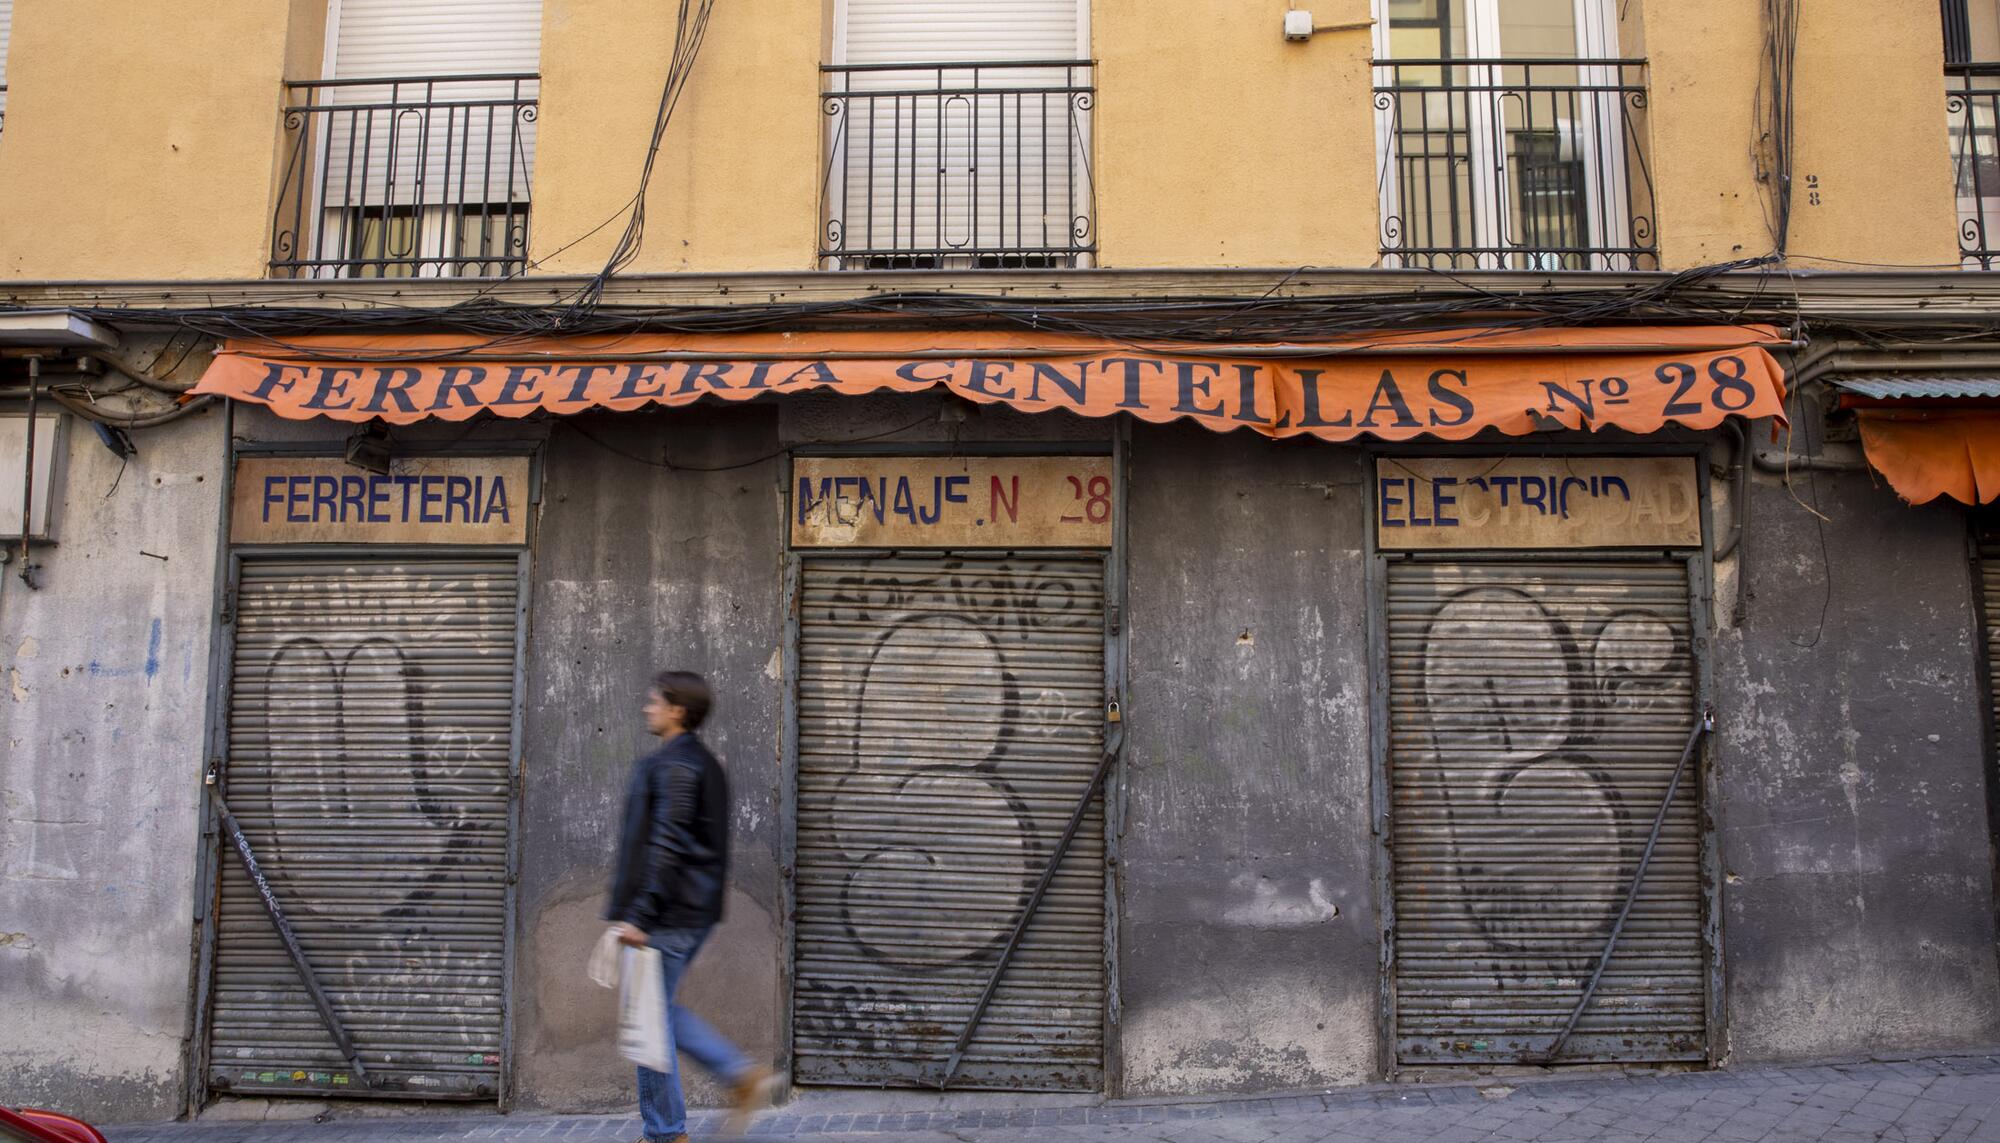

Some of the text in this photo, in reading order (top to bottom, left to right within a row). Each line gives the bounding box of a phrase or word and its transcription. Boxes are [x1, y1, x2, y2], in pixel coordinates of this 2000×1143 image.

[243, 361, 843, 412] FERRETERIA
[896, 358, 1474, 428] CENTELLAS
[1655, 356, 1756, 416] 28
[262, 475, 510, 523] FERRETERIA
